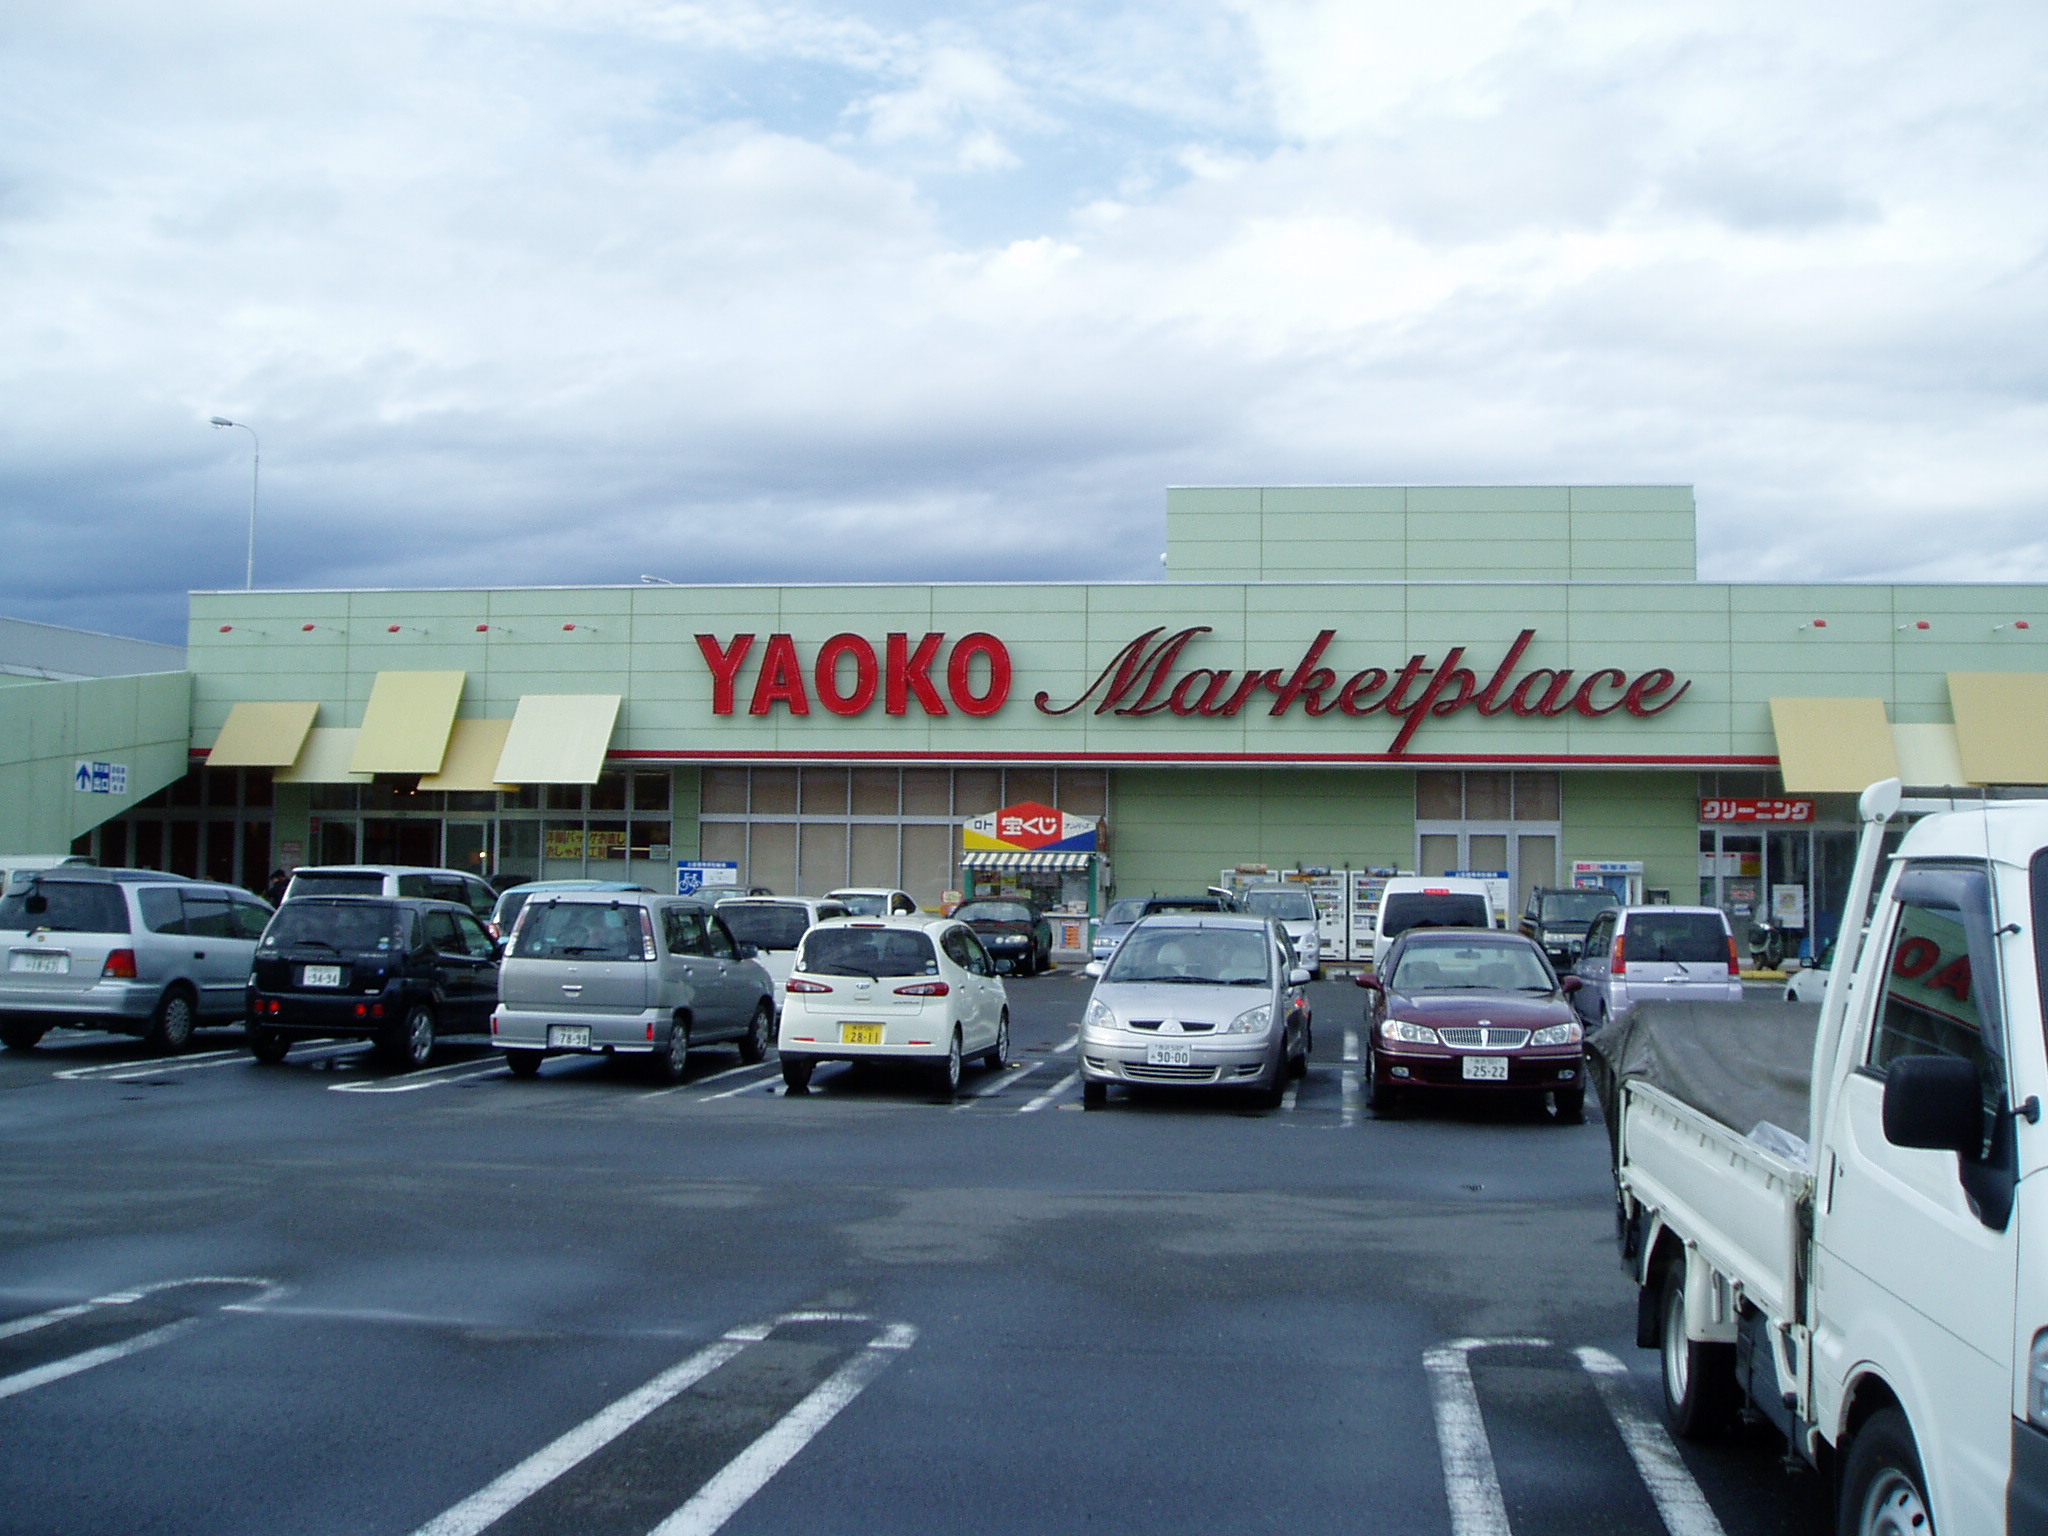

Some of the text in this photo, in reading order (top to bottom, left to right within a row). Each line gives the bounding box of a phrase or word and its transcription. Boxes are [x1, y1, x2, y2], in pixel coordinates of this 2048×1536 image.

[694, 626, 1692, 754] YAOKO Marketplace
[1703, 801, 1811, 819] クリーニング
[974, 820, 993, 830] ロト
[1001, 816, 1058, 836] 宝くじ
[850, 1032, 878, 1043] 28-11
[1157, 1051, 1188, 1063] 90-00
[1473, 1065, 1505, 1078] 25-22
